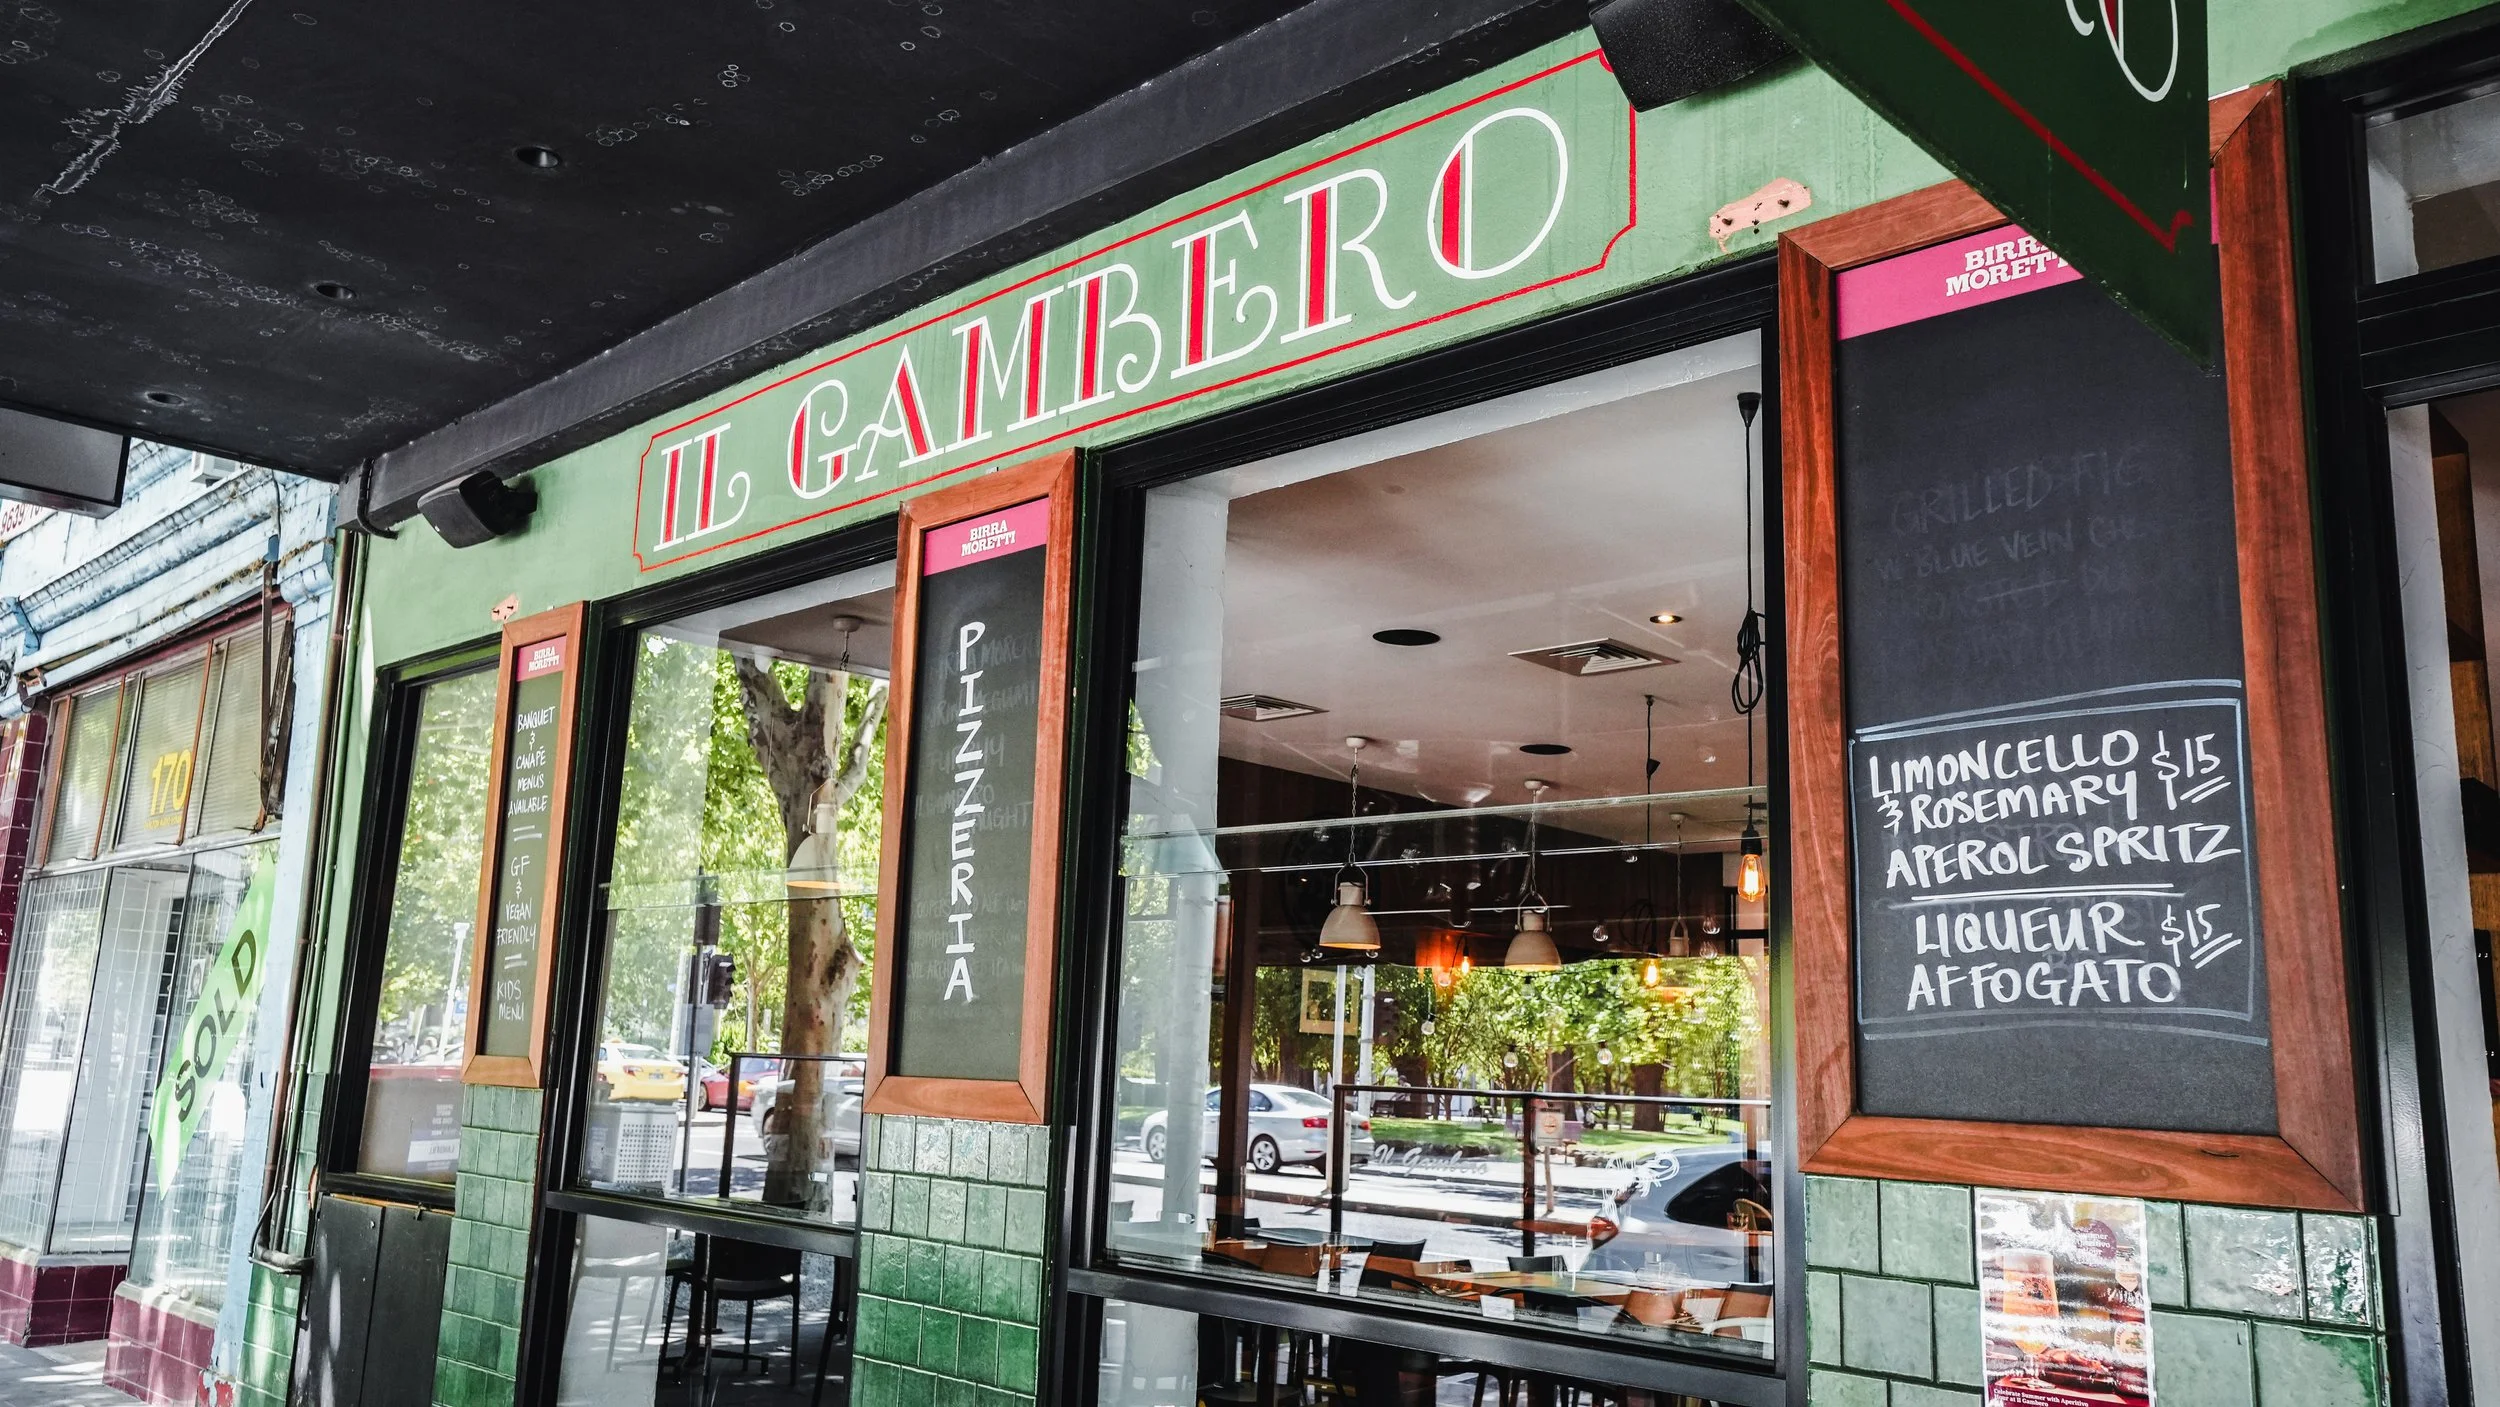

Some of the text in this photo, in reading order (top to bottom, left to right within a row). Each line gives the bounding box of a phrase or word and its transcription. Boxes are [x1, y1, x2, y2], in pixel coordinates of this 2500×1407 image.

[1964, 235, 2050, 272] BIRR
[654, 107, 1568, 552] IL GAMBERO
[961, 530, 1016, 557] MORETTI
[970, 519, 1008, 542] BIRRA
[517, 705, 556, 733] BANQUET
[150, 749, 191, 817] 170
[1869, 729, 2221, 810] LIMONCELLO $15
[507, 795, 549, 818] AVAILABLE
[943, 621, 985, 1002] PIZZERIA
[1911, 770, 2138, 834] ROSEMARY
[510, 855, 531, 877] GF
[1886, 822, 2241, 889] APEROL SPRITZ
[505, 897, 533, 922] VEGAN
[497, 923, 537, 950] FRIENDLY
[1915, 901, 2221, 967] LIQUEUR $15
[497, 979, 522, 1001] KIDS
[1907, 959, 2182, 1011] AFFOGATO
[175, 929, 257, 1123] SOLD
[498, 1002, 525, 1021] MENU
[1402, 1147, 1489, 1177] Gambero
[1993, 1388, 2021, 1397] Celebrate
[2021, 1392, 2046, 1401] Summer
[2060, 1398, 2089, 1407] Aperitivo
[2022, 1398, 2048, 1407] Gambero
